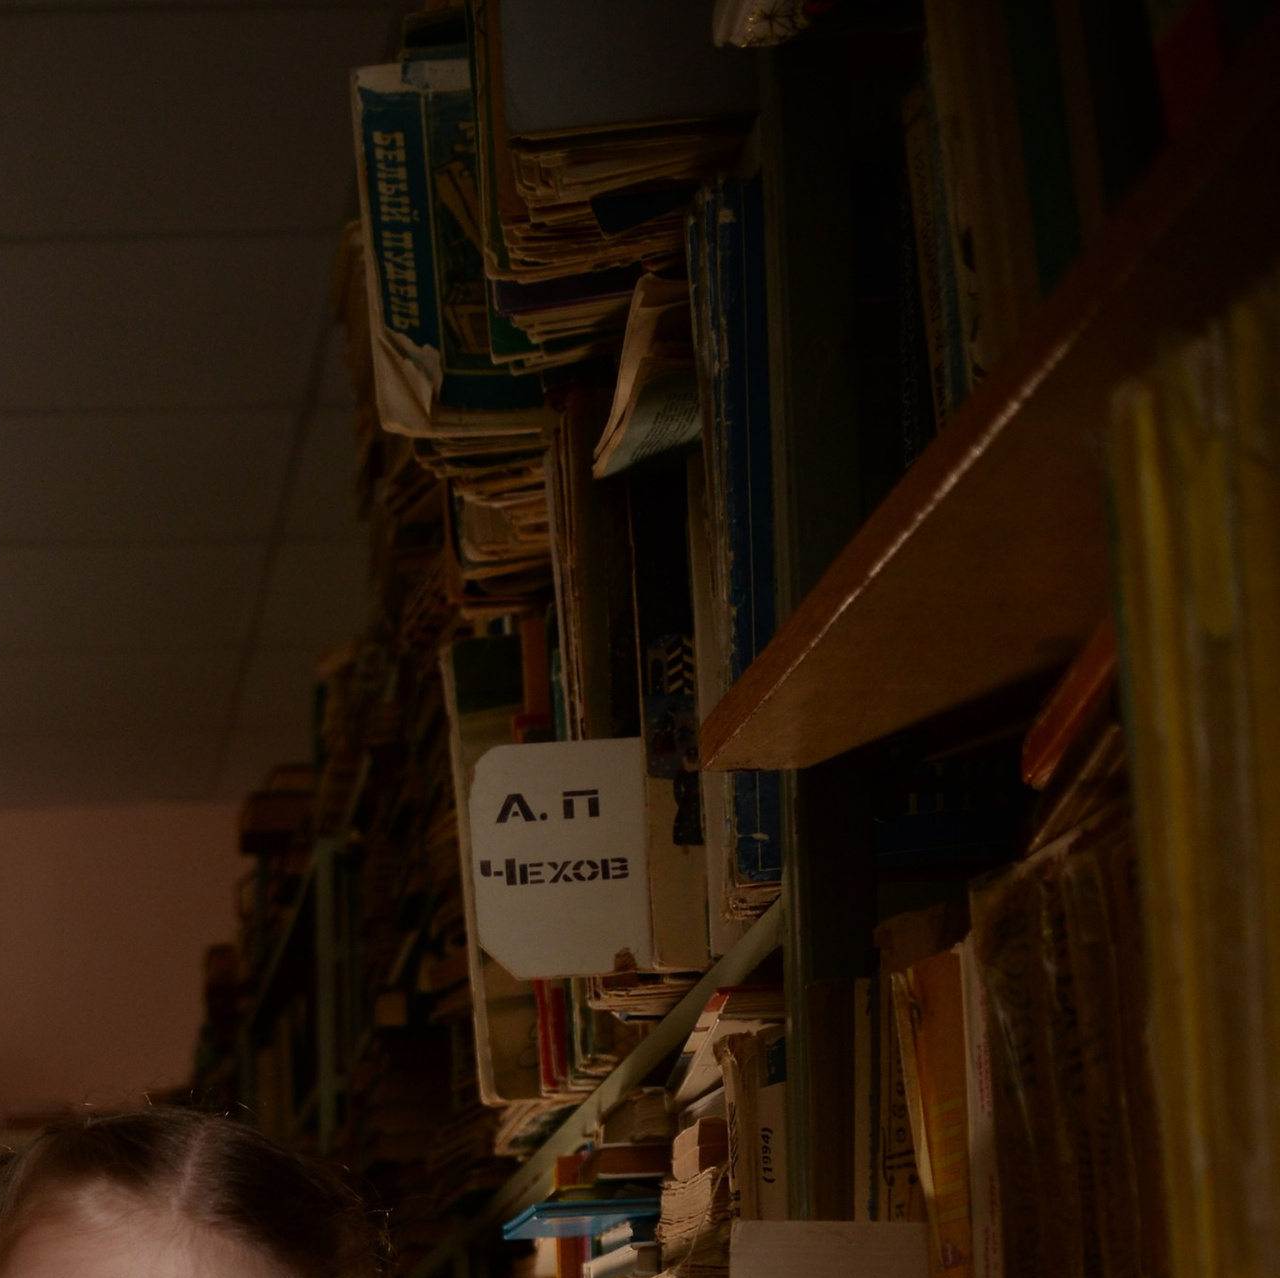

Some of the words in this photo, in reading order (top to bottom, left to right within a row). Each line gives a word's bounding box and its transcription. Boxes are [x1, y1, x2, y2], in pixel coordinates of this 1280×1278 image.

[372, 130, 420, 223] БЕЛЫЙ
[382, 230, 420, 329] ПУДЕЛЬ
[495, 791, 548, 824] А.
[562, 788, 599, 819] П
[761, 1127, 776, 1184] (1994)
